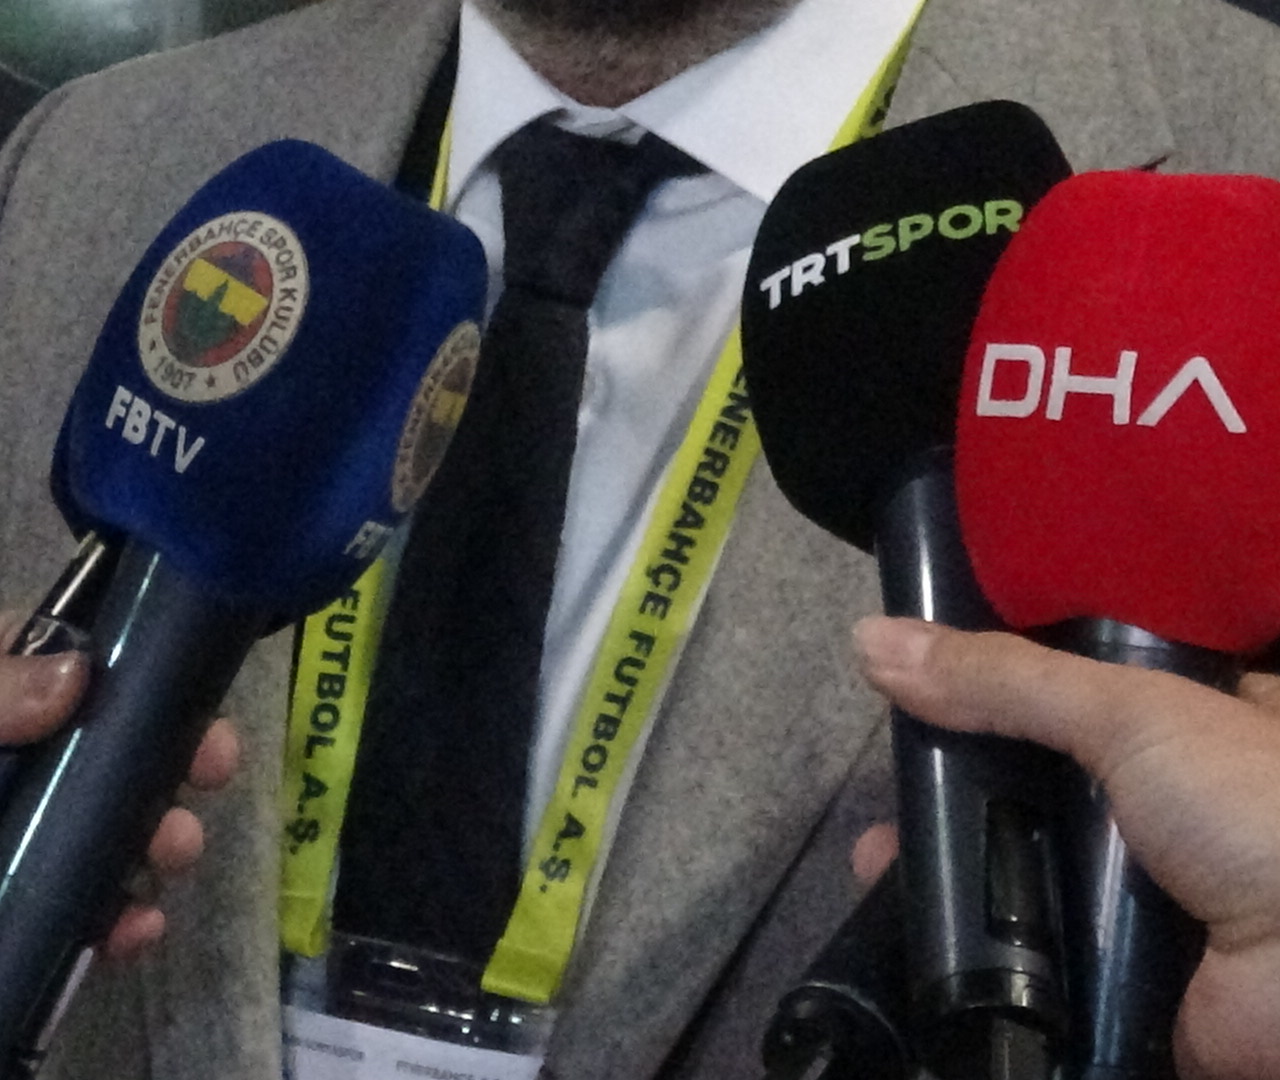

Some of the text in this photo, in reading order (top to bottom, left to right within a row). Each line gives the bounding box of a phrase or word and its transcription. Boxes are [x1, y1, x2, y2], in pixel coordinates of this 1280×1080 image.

[143, 218, 264, 325] FENERBAHÇE
[259, 227, 298, 283] SPOR
[153, 356, 198, 391] 1907
[975, 342, 1248, 434] DHA
[104, 385, 206, 475] FBTV
[638, 367, 751, 622] NERBAHÇE
[572, 628, 657, 799] FUTBOL
